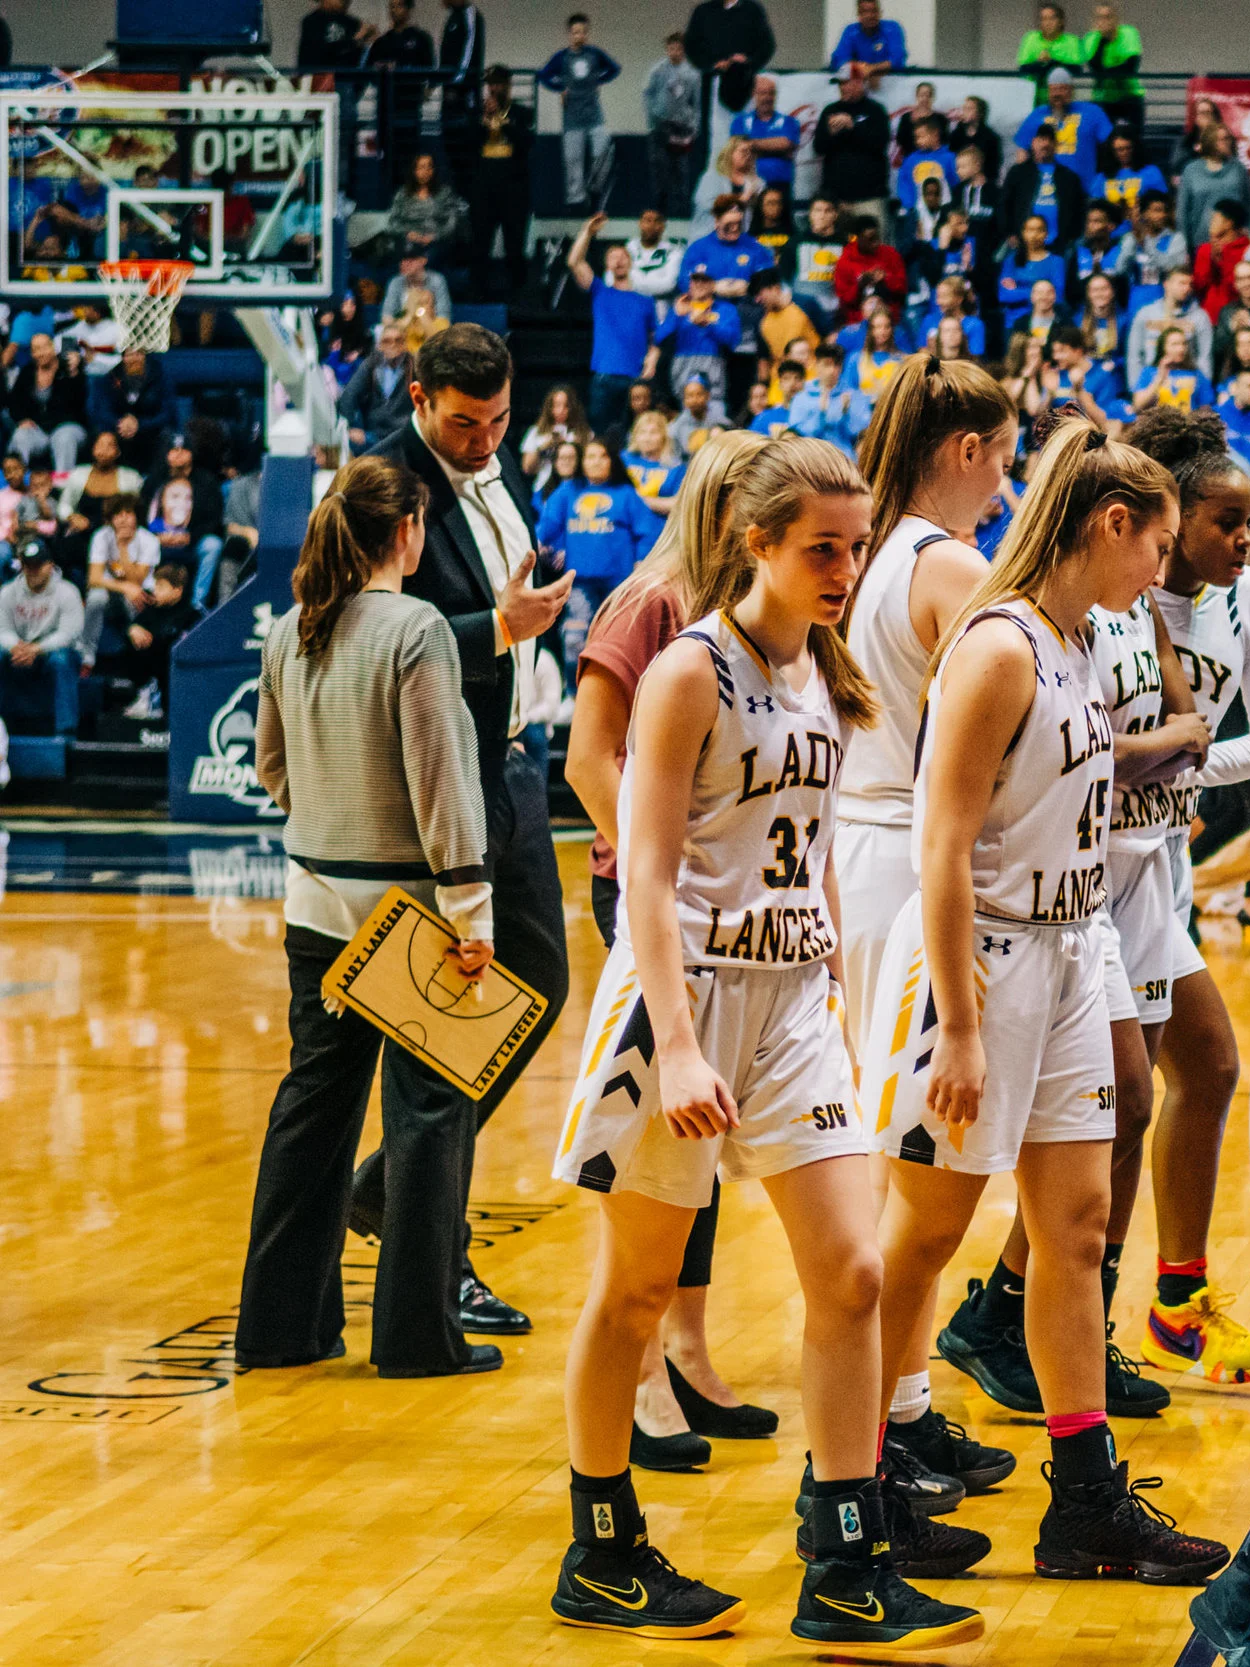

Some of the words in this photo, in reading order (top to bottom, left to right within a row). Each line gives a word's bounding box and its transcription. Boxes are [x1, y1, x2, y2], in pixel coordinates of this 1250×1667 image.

[193, 128, 315, 175] OPEN
[736, 732, 844, 806] LADY
[761, 815, 821, 891] 31
[336, 956, 370, 994] LADY
[363, 899, 409, 955] LANCERS
[474, 1058, 503, 1093] LADY
[499, 1002, 543, 1058] LANCERS
